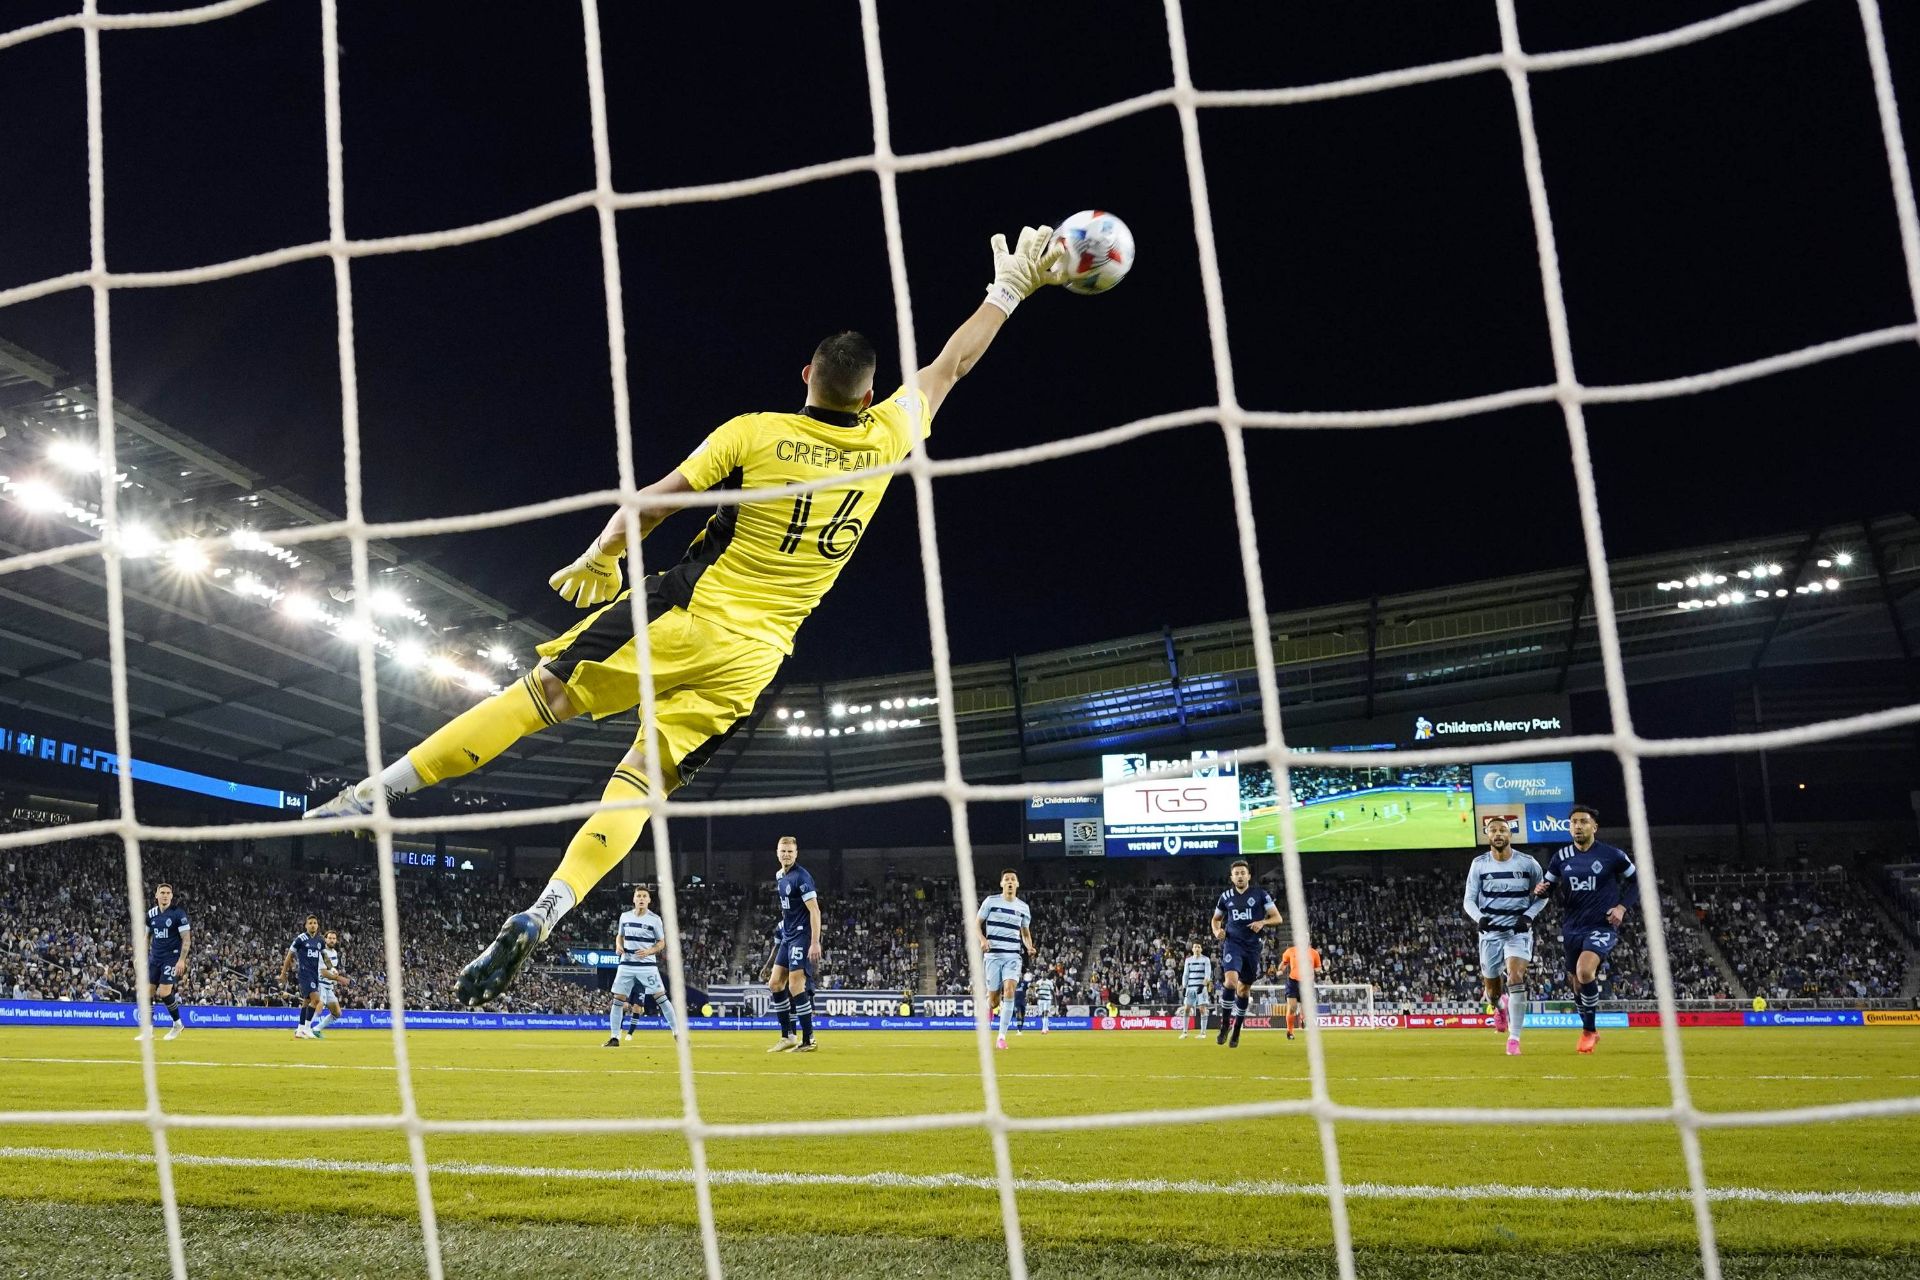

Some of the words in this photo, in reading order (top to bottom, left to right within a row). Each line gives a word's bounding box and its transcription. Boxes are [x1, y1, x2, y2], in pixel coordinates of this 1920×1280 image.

[776, 440, 879, 472] CREPEAU
[779, 482, 865, 562] 16
[1436, 720, 1492, 734] Children's
[1494, 720, 1530, 732] Mercy
[1532, 717, 1561, 730] Park
[1495, 776, 1546, 788] Compass
[1525, 787, 1562, 796] Minerals
[1076, 796, 1098, 805] Mercy
[1135, 788, 1208, 814] TGS
[1028, 832, 1062, 843] UMB
[1128, 842, 1162, 850] VICTORY
[1183, 840, 1219, 849] PROJECT
[1569, 876, 1597, 891] Bell
[1232, 908, 1252, 921] Bell
[154, 928, 169, 939] Bell
[600, 954, 619, 964] COFFEE
[791, 946, 804, 960] 15
[0, 1008, 14, 1016] fficial
[15, 1008, 29, 1017] Plant
[30, 1009, 52, 1017] Nutrition
[63, 1010, 73, 1018] Salt
[73, 1010, 93, 1018] Provider
[100, 1010, 119, 1020] Sporting
[826, 1000, 856, 1016] OUR
[863, 1000, 898, 1016] CITY
[1120, 1018, 1143, 1028] Captain
[1143, 1018, 1167, 1029] Morgan
[1532, 1017, 1573, 1025] KC2026
[1867, 1014, 1912, 1023] Continental
